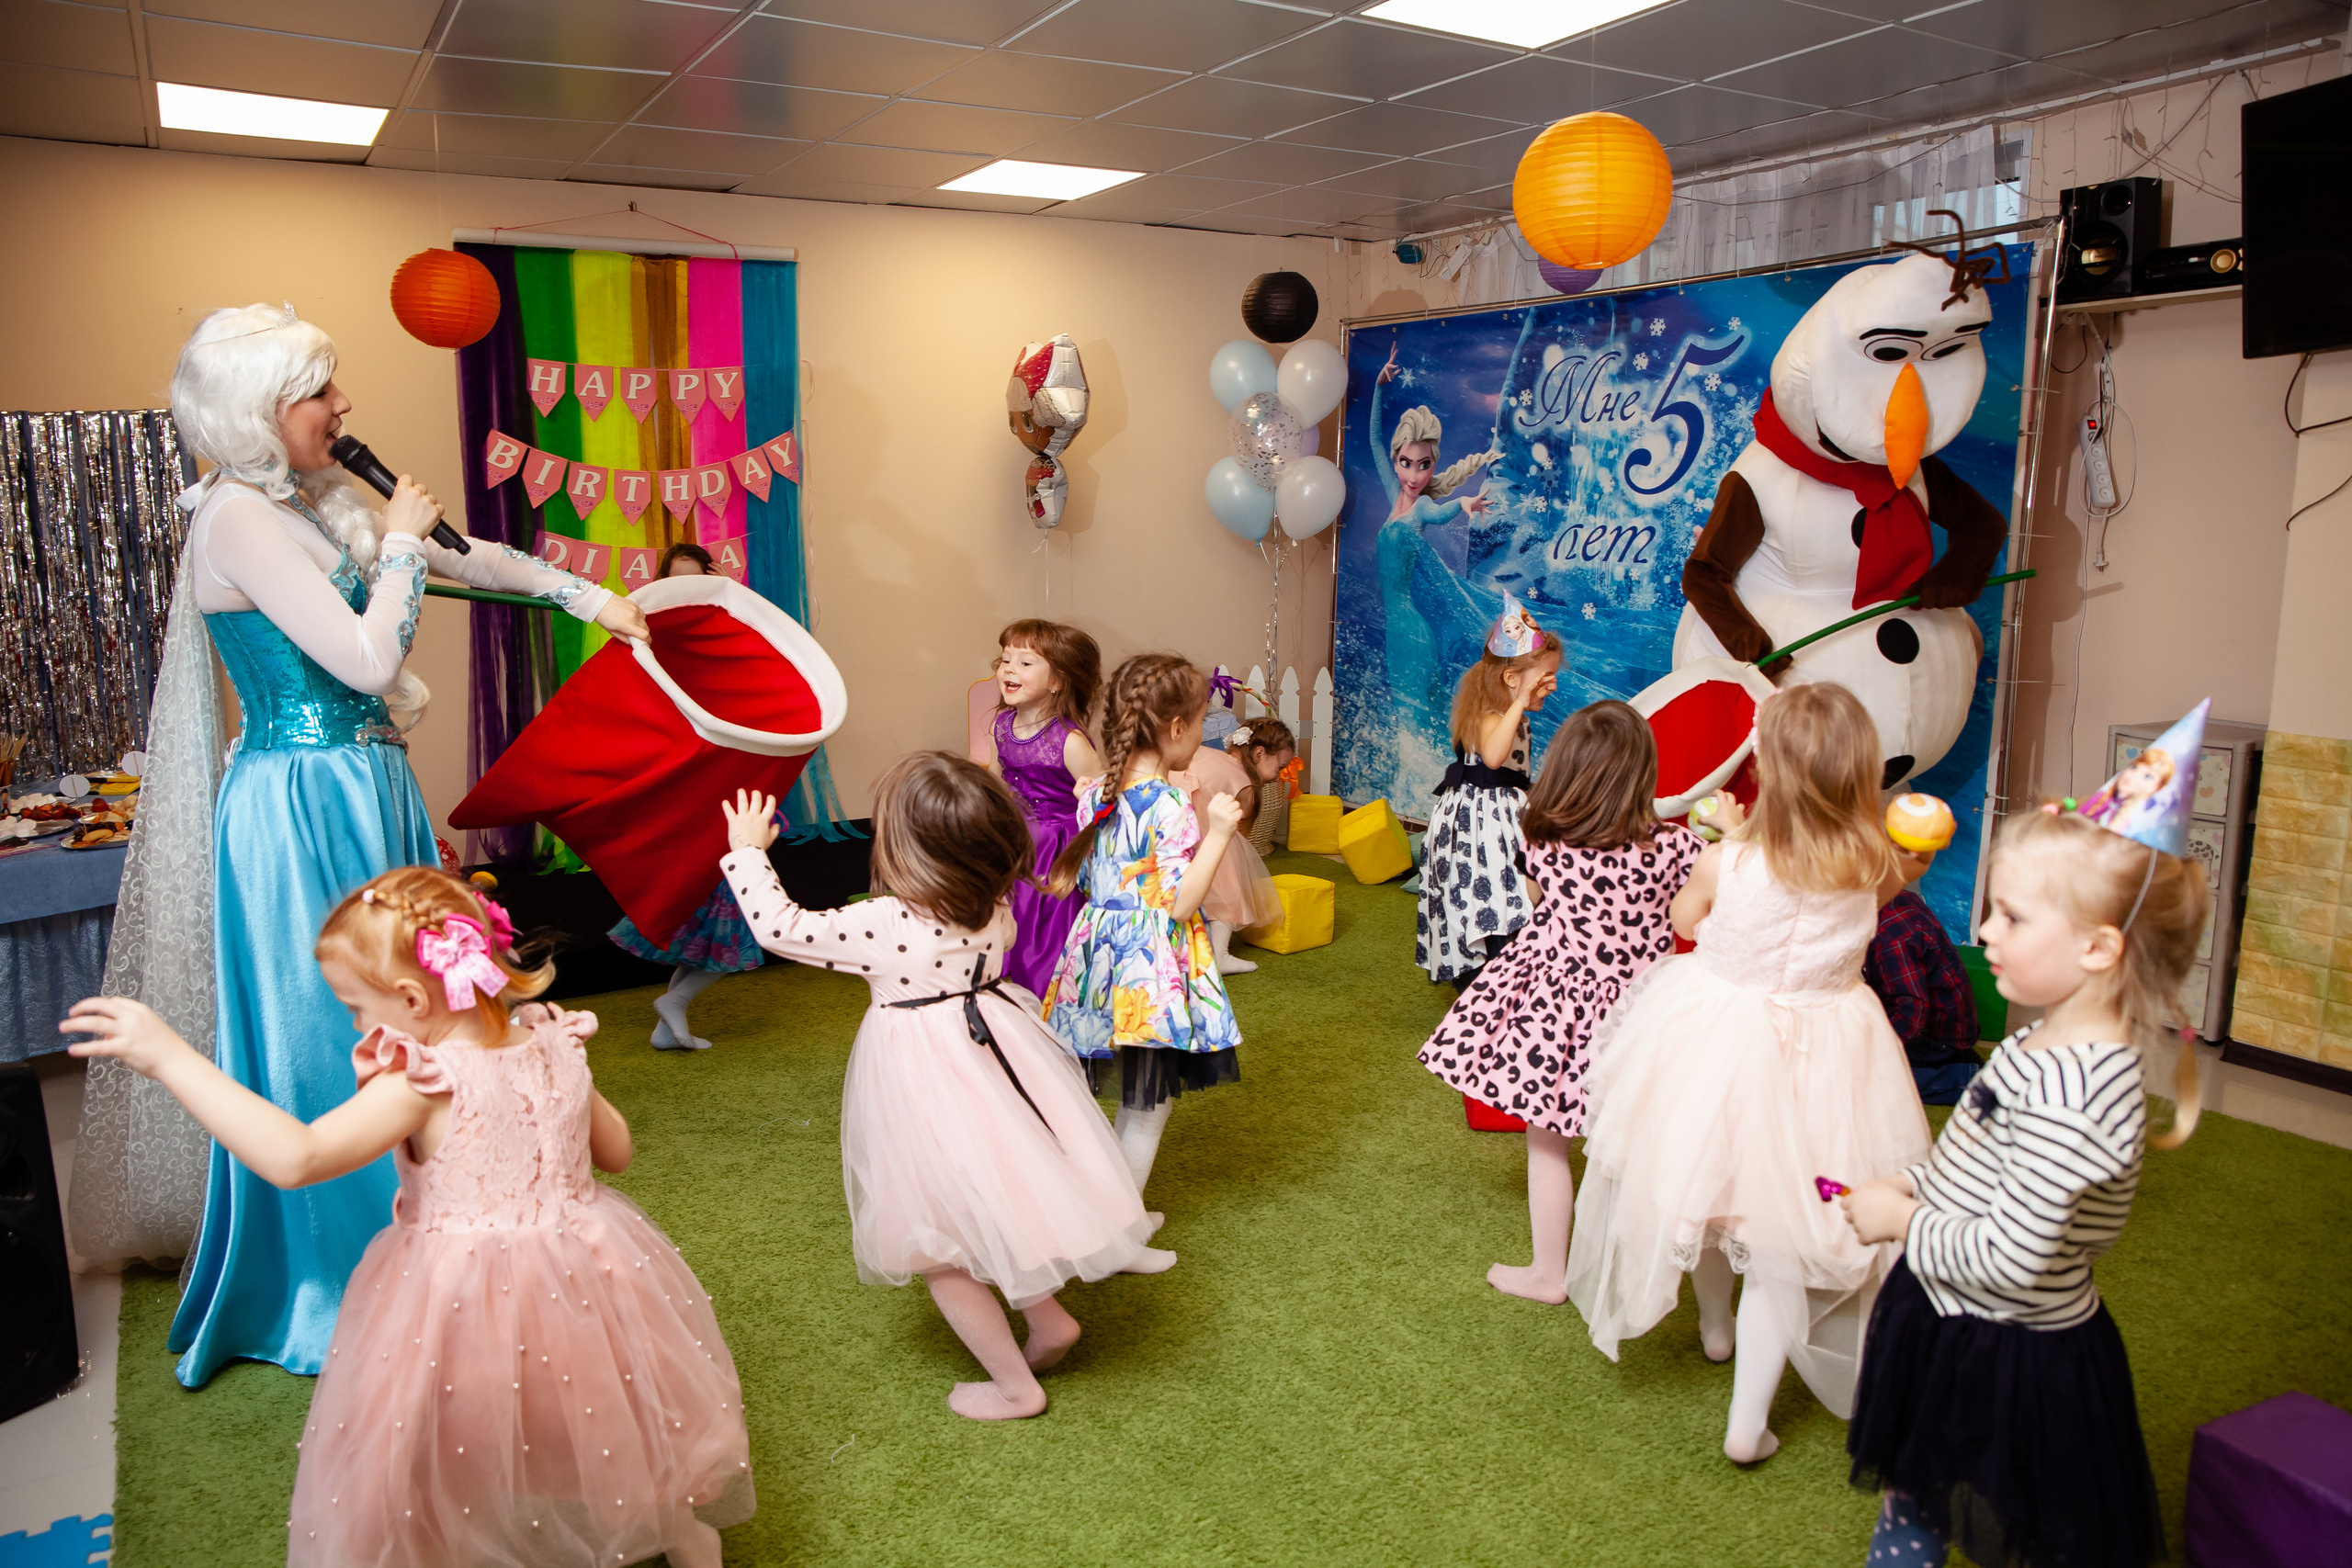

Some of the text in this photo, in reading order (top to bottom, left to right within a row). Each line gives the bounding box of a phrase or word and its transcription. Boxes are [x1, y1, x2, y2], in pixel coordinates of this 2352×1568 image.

[530, 365, 739, 400] HAPPY
[1518, 334, 1746, 495] Мне 5
[487, 437, 793, 502] BIRTHDAY
[544, 537, 741, 580] DIAA
[1553, 525, 1657, 565] лет
